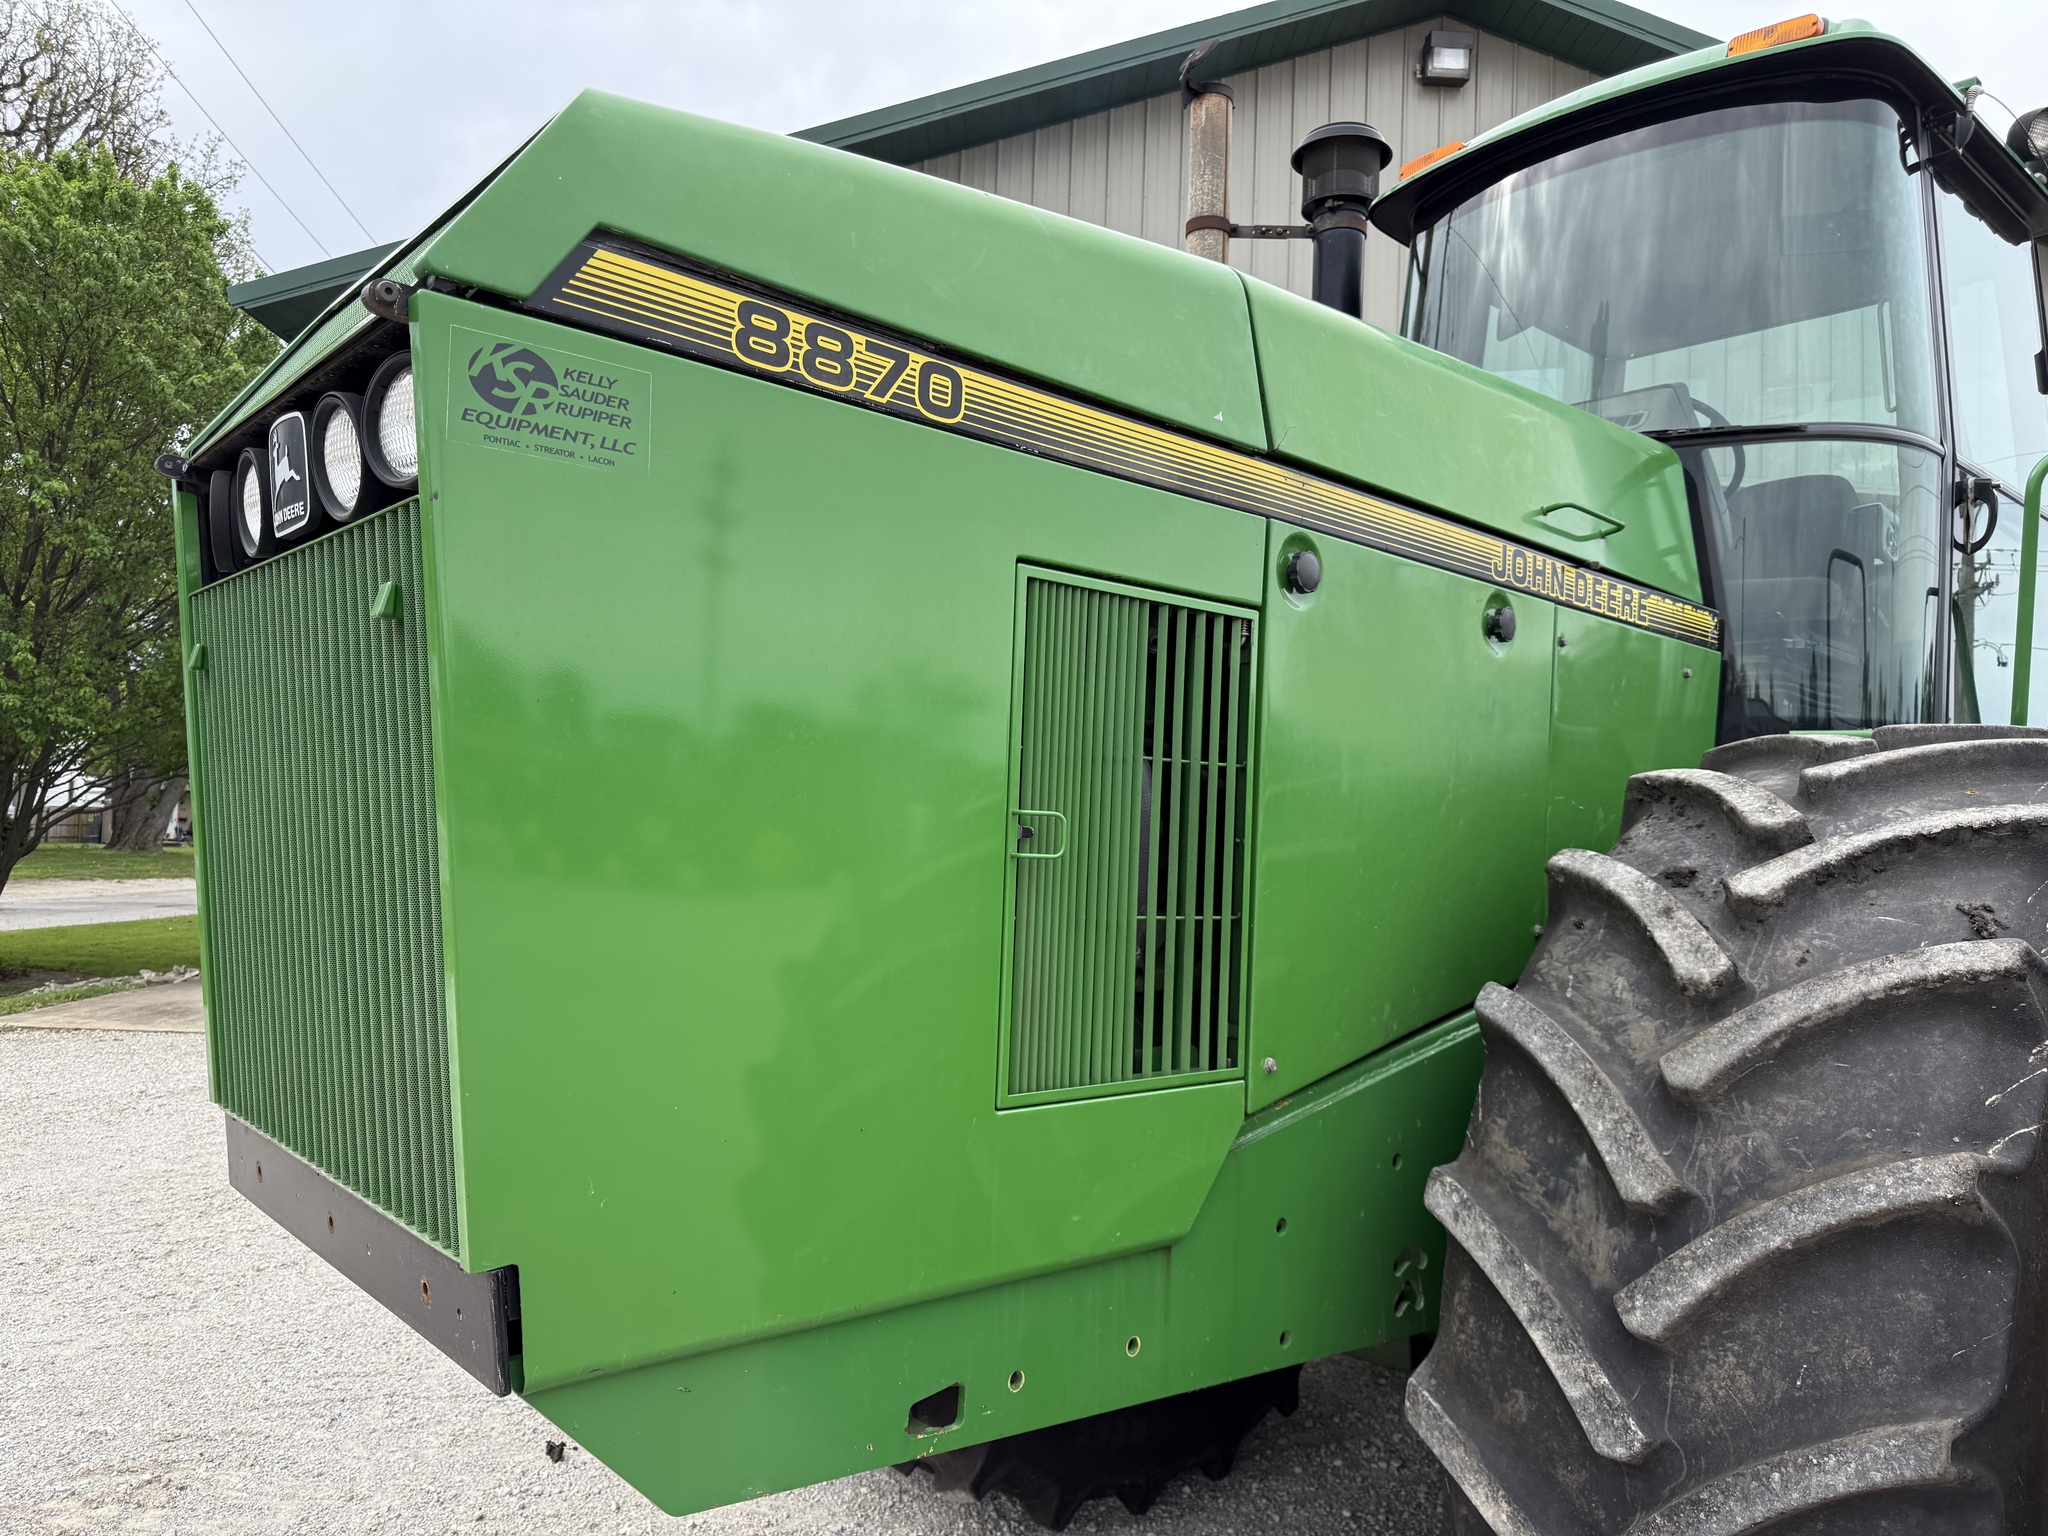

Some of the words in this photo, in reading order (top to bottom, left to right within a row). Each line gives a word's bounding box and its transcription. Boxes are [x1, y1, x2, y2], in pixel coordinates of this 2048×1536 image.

[731, 299, 966, 424] 8870
[563, 367, 619, 390] KELLY
[558, 384, 630, 411] SAUDER
[555, 401, 632, 429] RUPIPER
[460, 407, 595, 450] EQUIPMENT,
[599, 436, 637, 456] LLC
[483, 434, 521, 448] PONTIAC
[533, 444, 576, 459] STREATOR
[588, 454, 616, 467] LACON
[283, 501, 305, 521] DEERE
[1492, 544, 1566, 601] JOHN
[1573, 569, 1649, 626] DEERE
